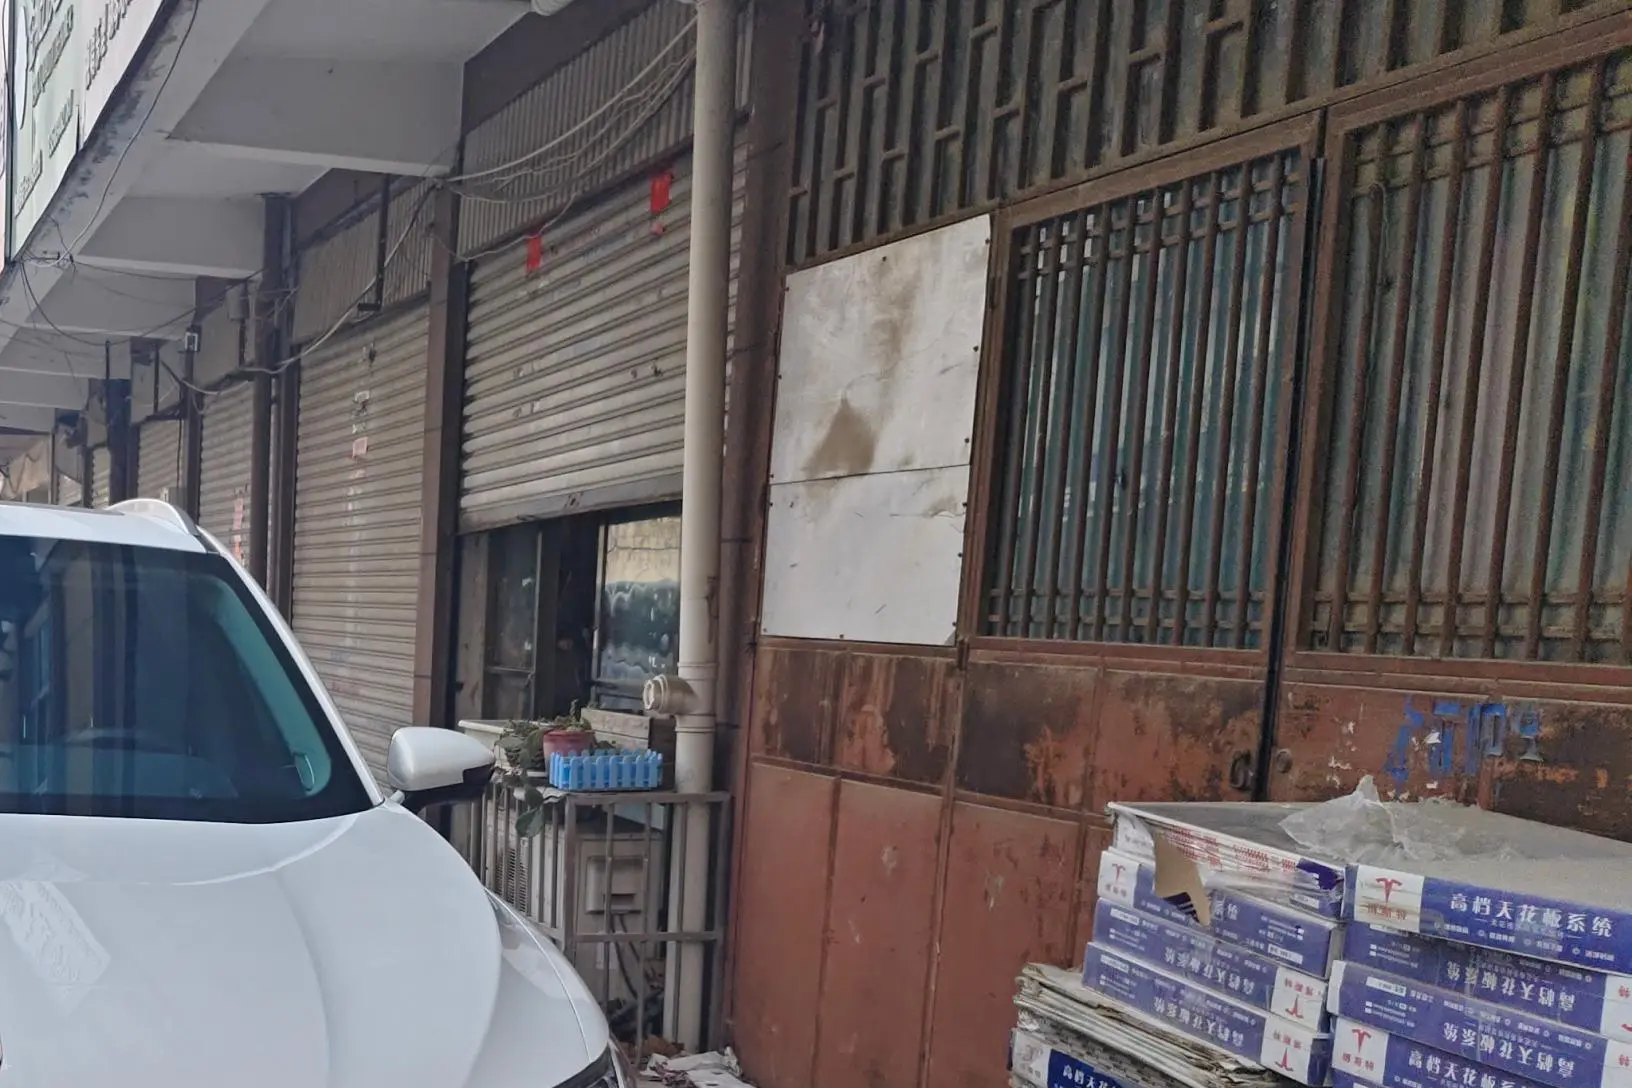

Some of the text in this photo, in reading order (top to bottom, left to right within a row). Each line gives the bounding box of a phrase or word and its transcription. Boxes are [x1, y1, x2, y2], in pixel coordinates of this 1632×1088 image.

[1450, 892, 1613, 939] 高档天花板系统
